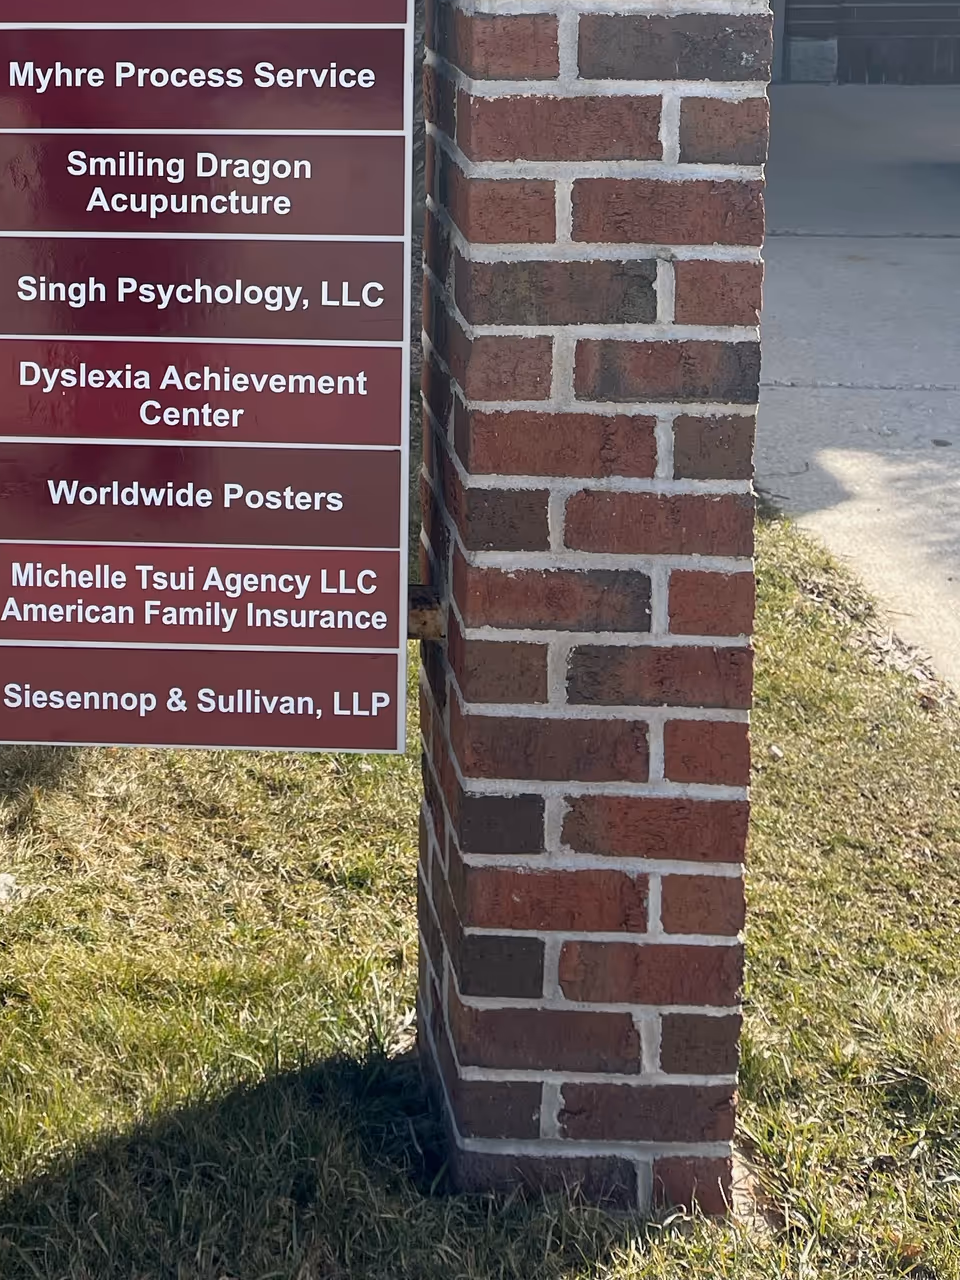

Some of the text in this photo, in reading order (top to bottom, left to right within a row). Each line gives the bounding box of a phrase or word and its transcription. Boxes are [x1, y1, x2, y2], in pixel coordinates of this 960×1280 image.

[10, 62, 375, 93] Myhre Process Service
[67, 151, 310, 184] Smiling Dragon
[86, 187, 290, 218] Acupuncture
[18, 276, 383, 311] Singh Psychology, LLC
[20, 362, 367, 395] Dyslexia Achievement
[140, 401, 244, 427] Center
[48, 480, 342, 510] Worldwide Posters
[12, 563, 376, 599] Michelle Tsui Agency LLC
[1, 598, 387, 632] American Family Insurance
[4, 684, 389, 719] Siesennop & Sullivan, LLP
